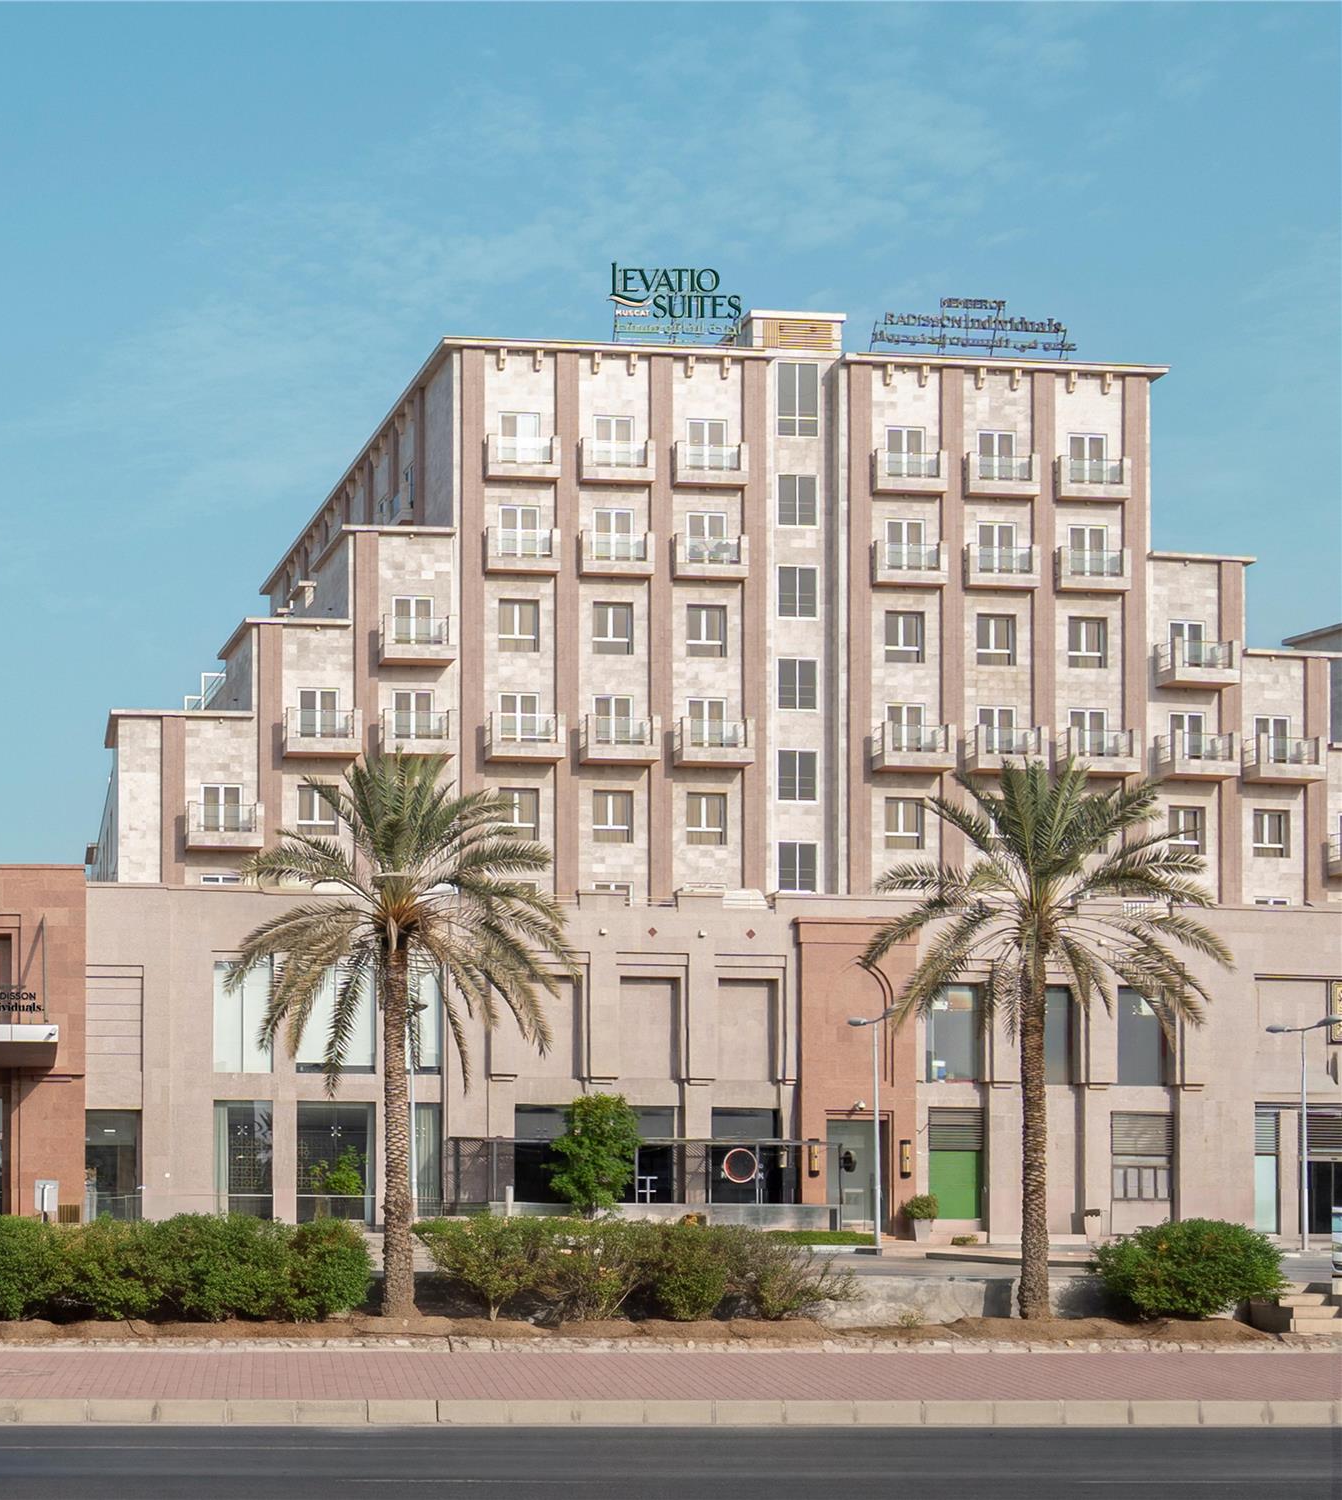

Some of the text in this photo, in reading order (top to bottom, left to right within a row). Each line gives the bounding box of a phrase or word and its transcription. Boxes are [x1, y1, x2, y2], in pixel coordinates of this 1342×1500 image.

[609, 261, 720, 303] LEVATIO
[652, 294, 742, 319] SUITES
[884, 311, 962, 329] RADISSON
